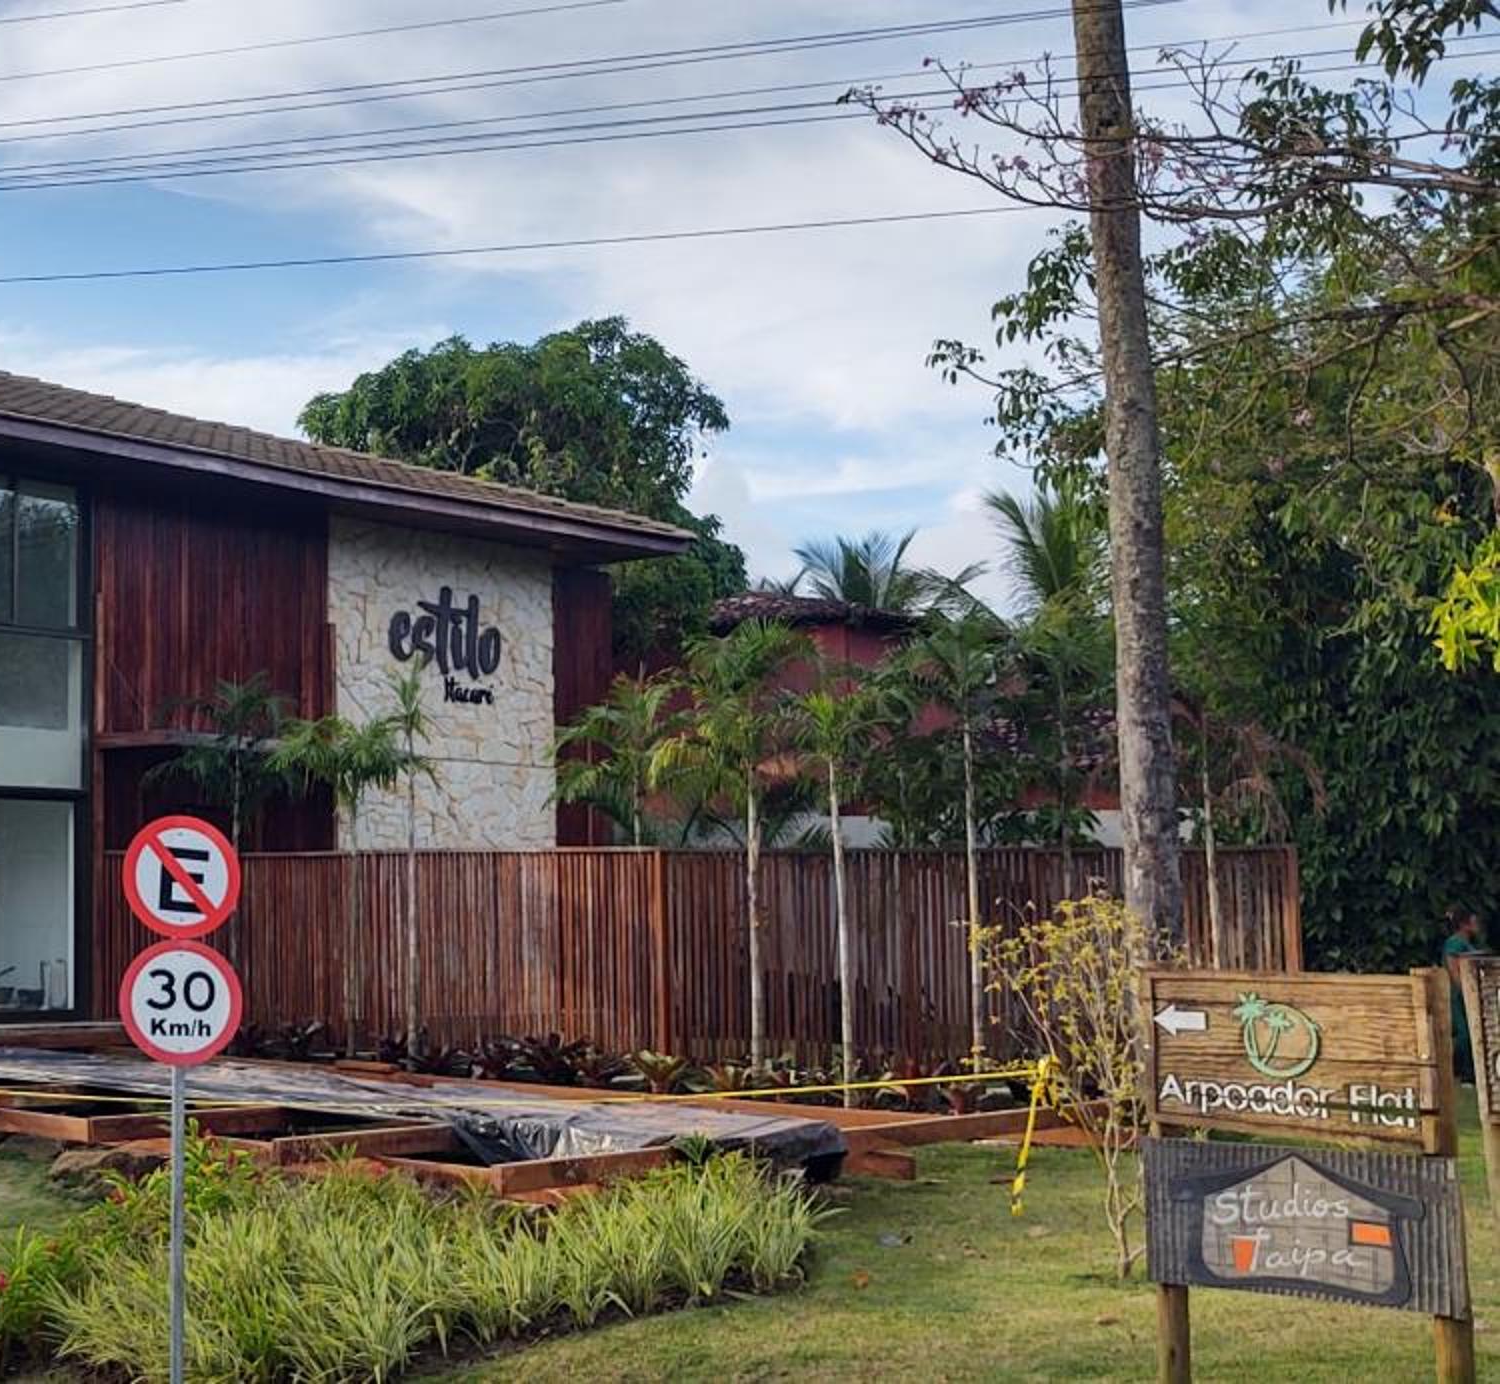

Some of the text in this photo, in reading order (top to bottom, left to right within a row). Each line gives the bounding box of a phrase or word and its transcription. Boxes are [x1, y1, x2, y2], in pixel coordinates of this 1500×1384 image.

[388, 585, 501, 680] estilo
[159, 846, 210, 915] E
[146, 969, 215, 1012] 30
[150, 1017, 212, 1037] Km/h
[1158, 1073, 1417, 1128] Arpoador Flat
[1212, 1182, 1350, 1226] Studios
[1228, 1226, 1365, 1276] Taipa
